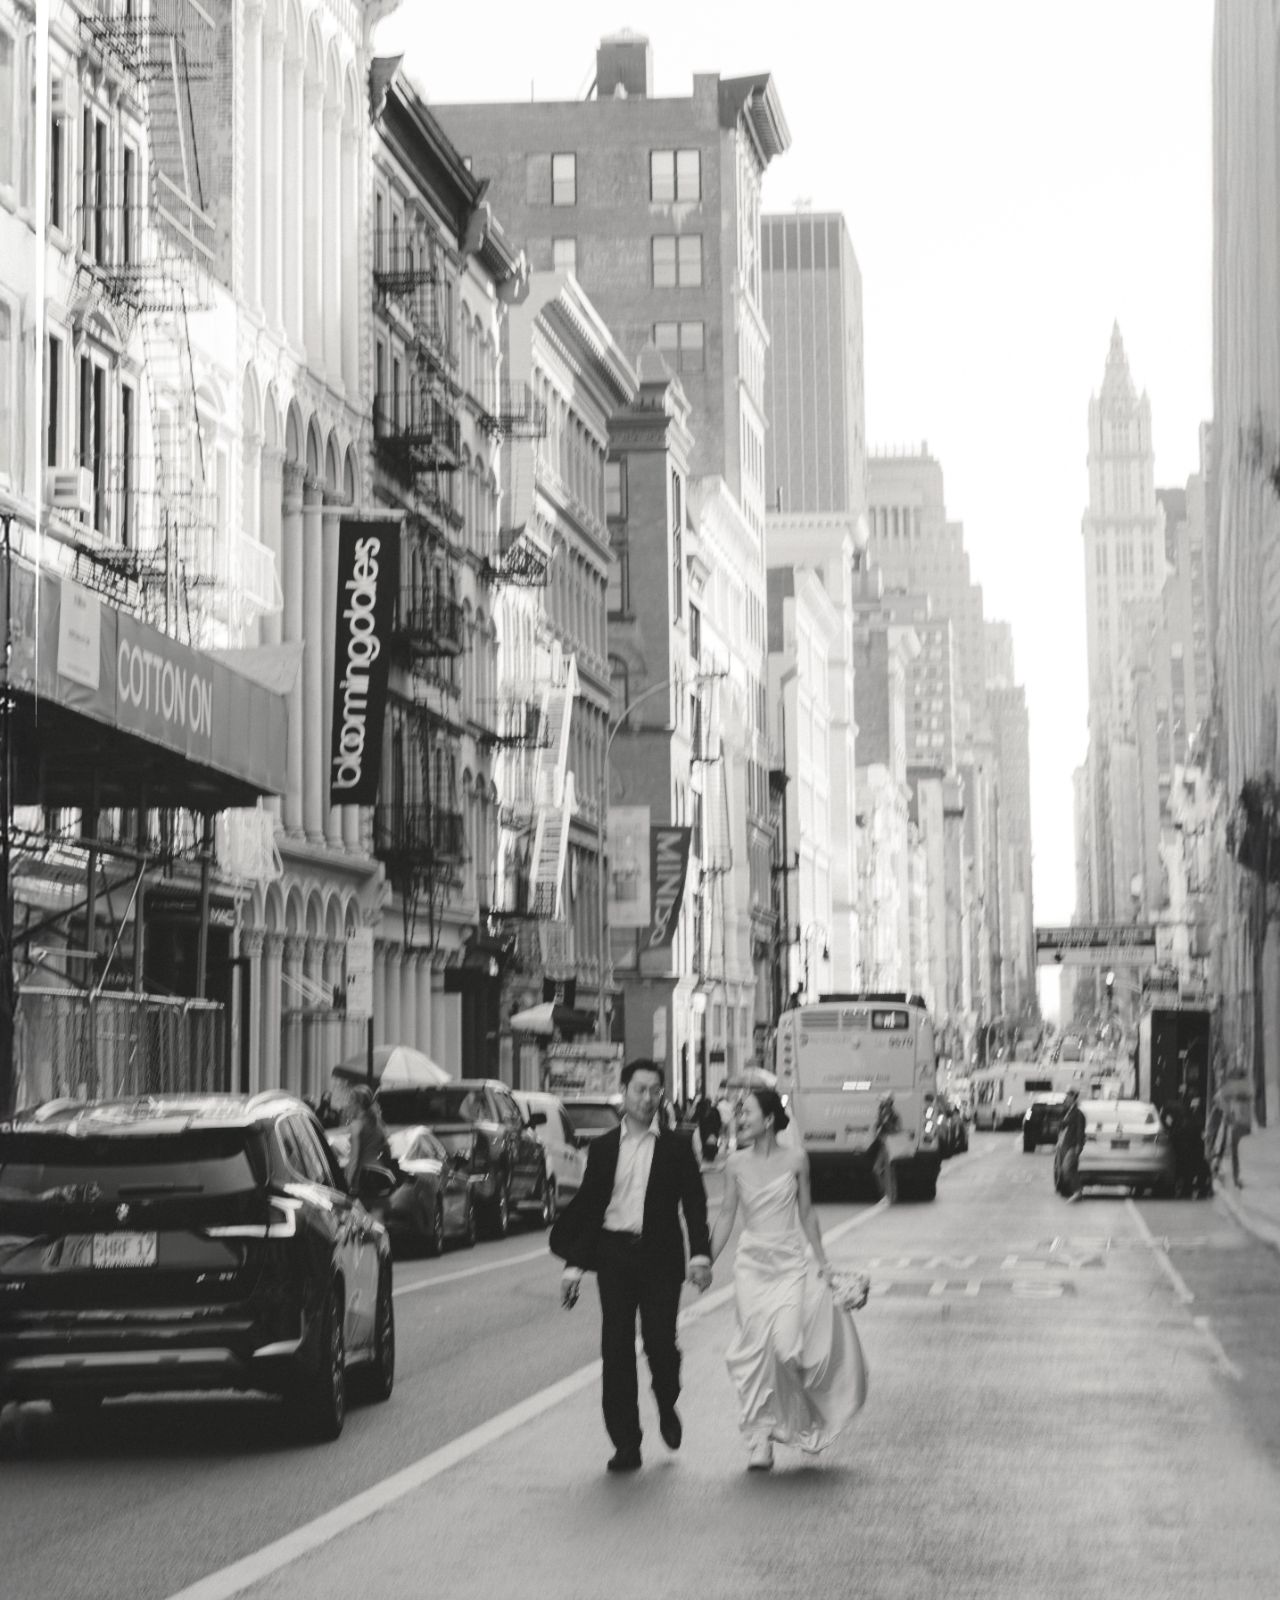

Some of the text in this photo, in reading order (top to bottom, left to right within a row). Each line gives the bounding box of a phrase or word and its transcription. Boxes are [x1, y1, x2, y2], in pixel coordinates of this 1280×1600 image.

[118, 638, 212, 738] COTTON ON
[650, 831, 683, 946] MINISO
